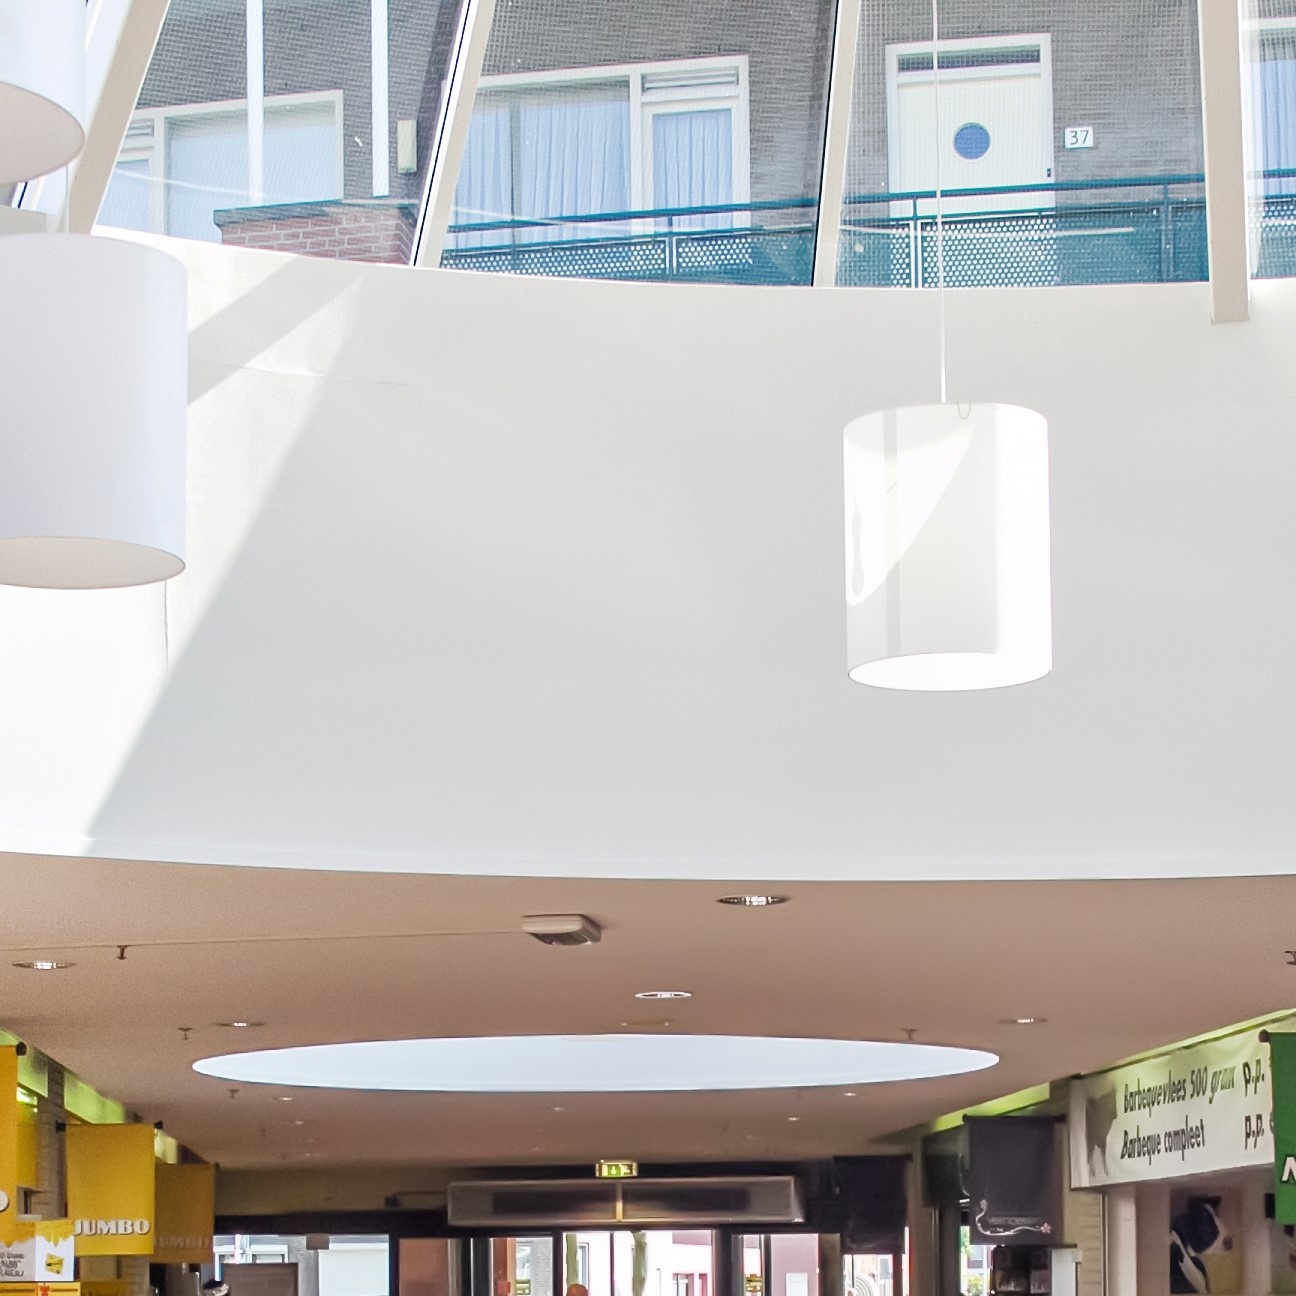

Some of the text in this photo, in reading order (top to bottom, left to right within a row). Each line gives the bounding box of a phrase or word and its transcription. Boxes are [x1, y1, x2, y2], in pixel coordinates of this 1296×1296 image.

[1069, 129, 1090, 146] 37
[1190, 1066, 1208, 1099] 500
[1120, 1125, 1162, 1166] Barbeque
[1163, 1115, 1206, 1161] compleet
[74, 1218, 151, 1236] JUMBO
